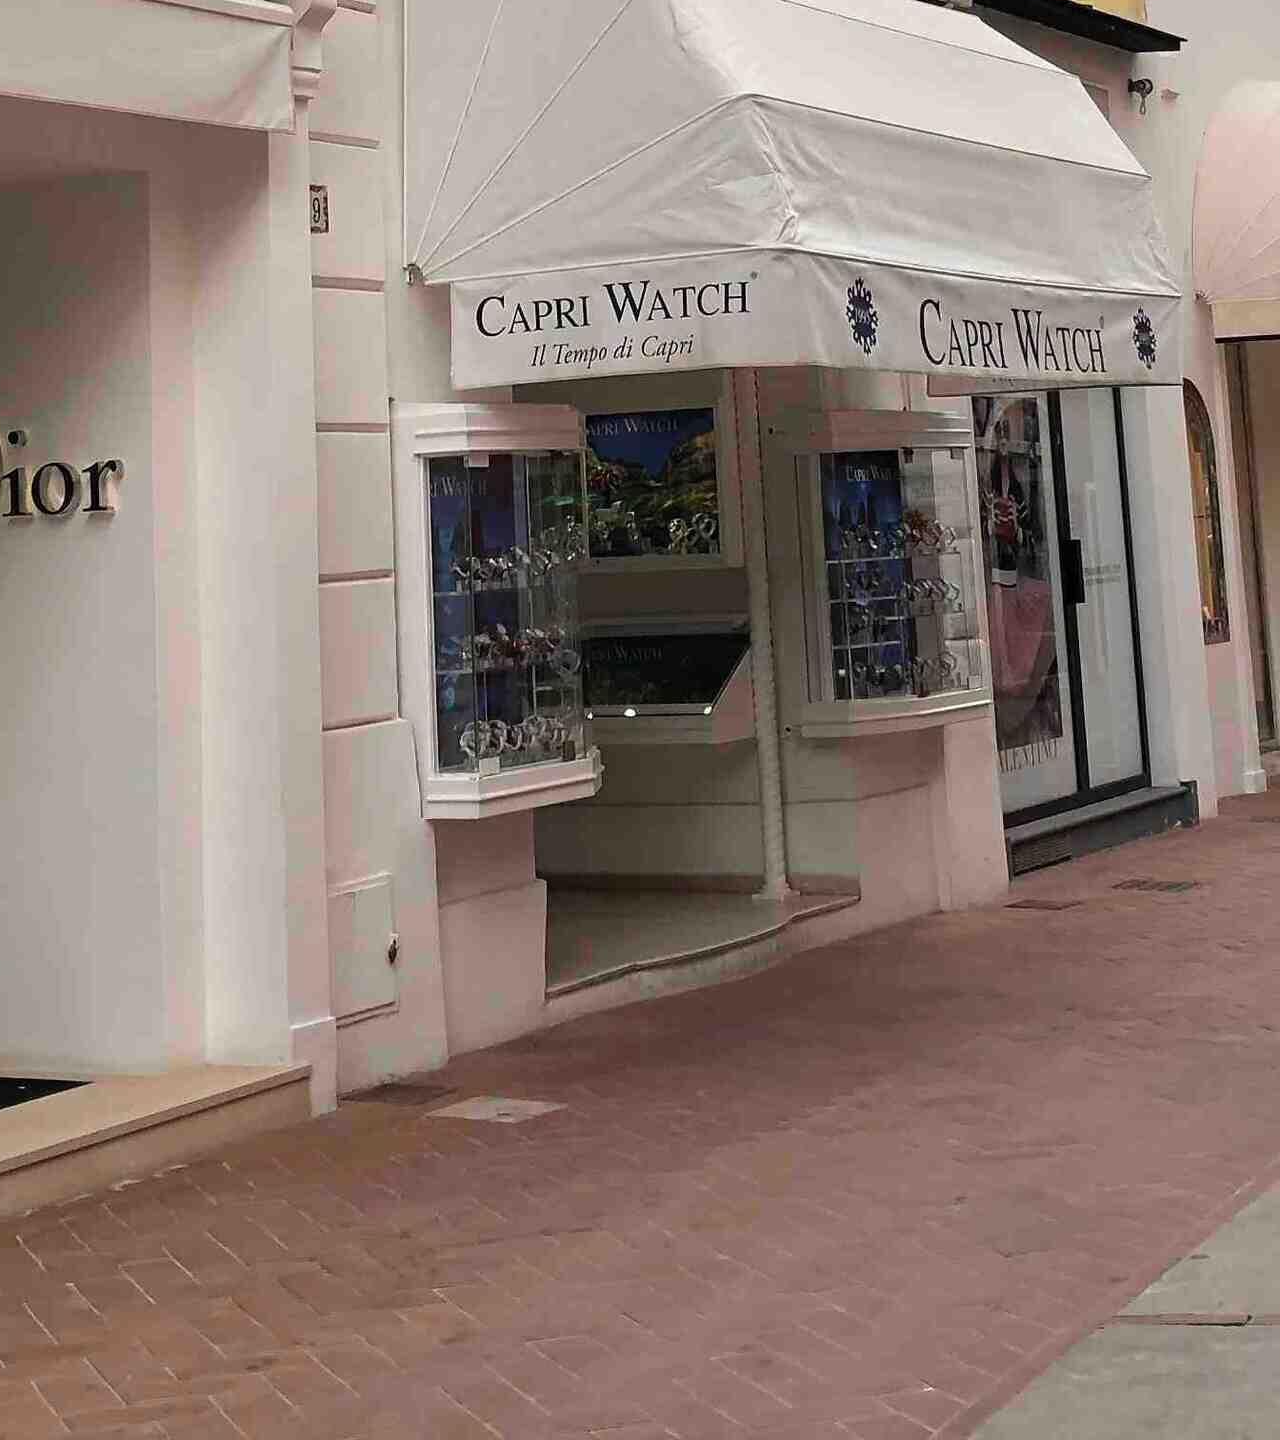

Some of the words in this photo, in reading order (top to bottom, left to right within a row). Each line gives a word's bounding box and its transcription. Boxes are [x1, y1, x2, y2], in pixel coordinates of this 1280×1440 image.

[312, 197, 321, 224] 9
[475, 295, 591, 337] CAPRI
[603, 280, 752, 323] WATCH
[531, 344, 547, 367] Il
[552, 343, 608, 369] Tempo
[613, 336, 634, 360] di
[641, 333, 695, 364] Capri
[919, 298, 1009, 369] CAPRI
[1010, 308, 1108, 374] WATCH
